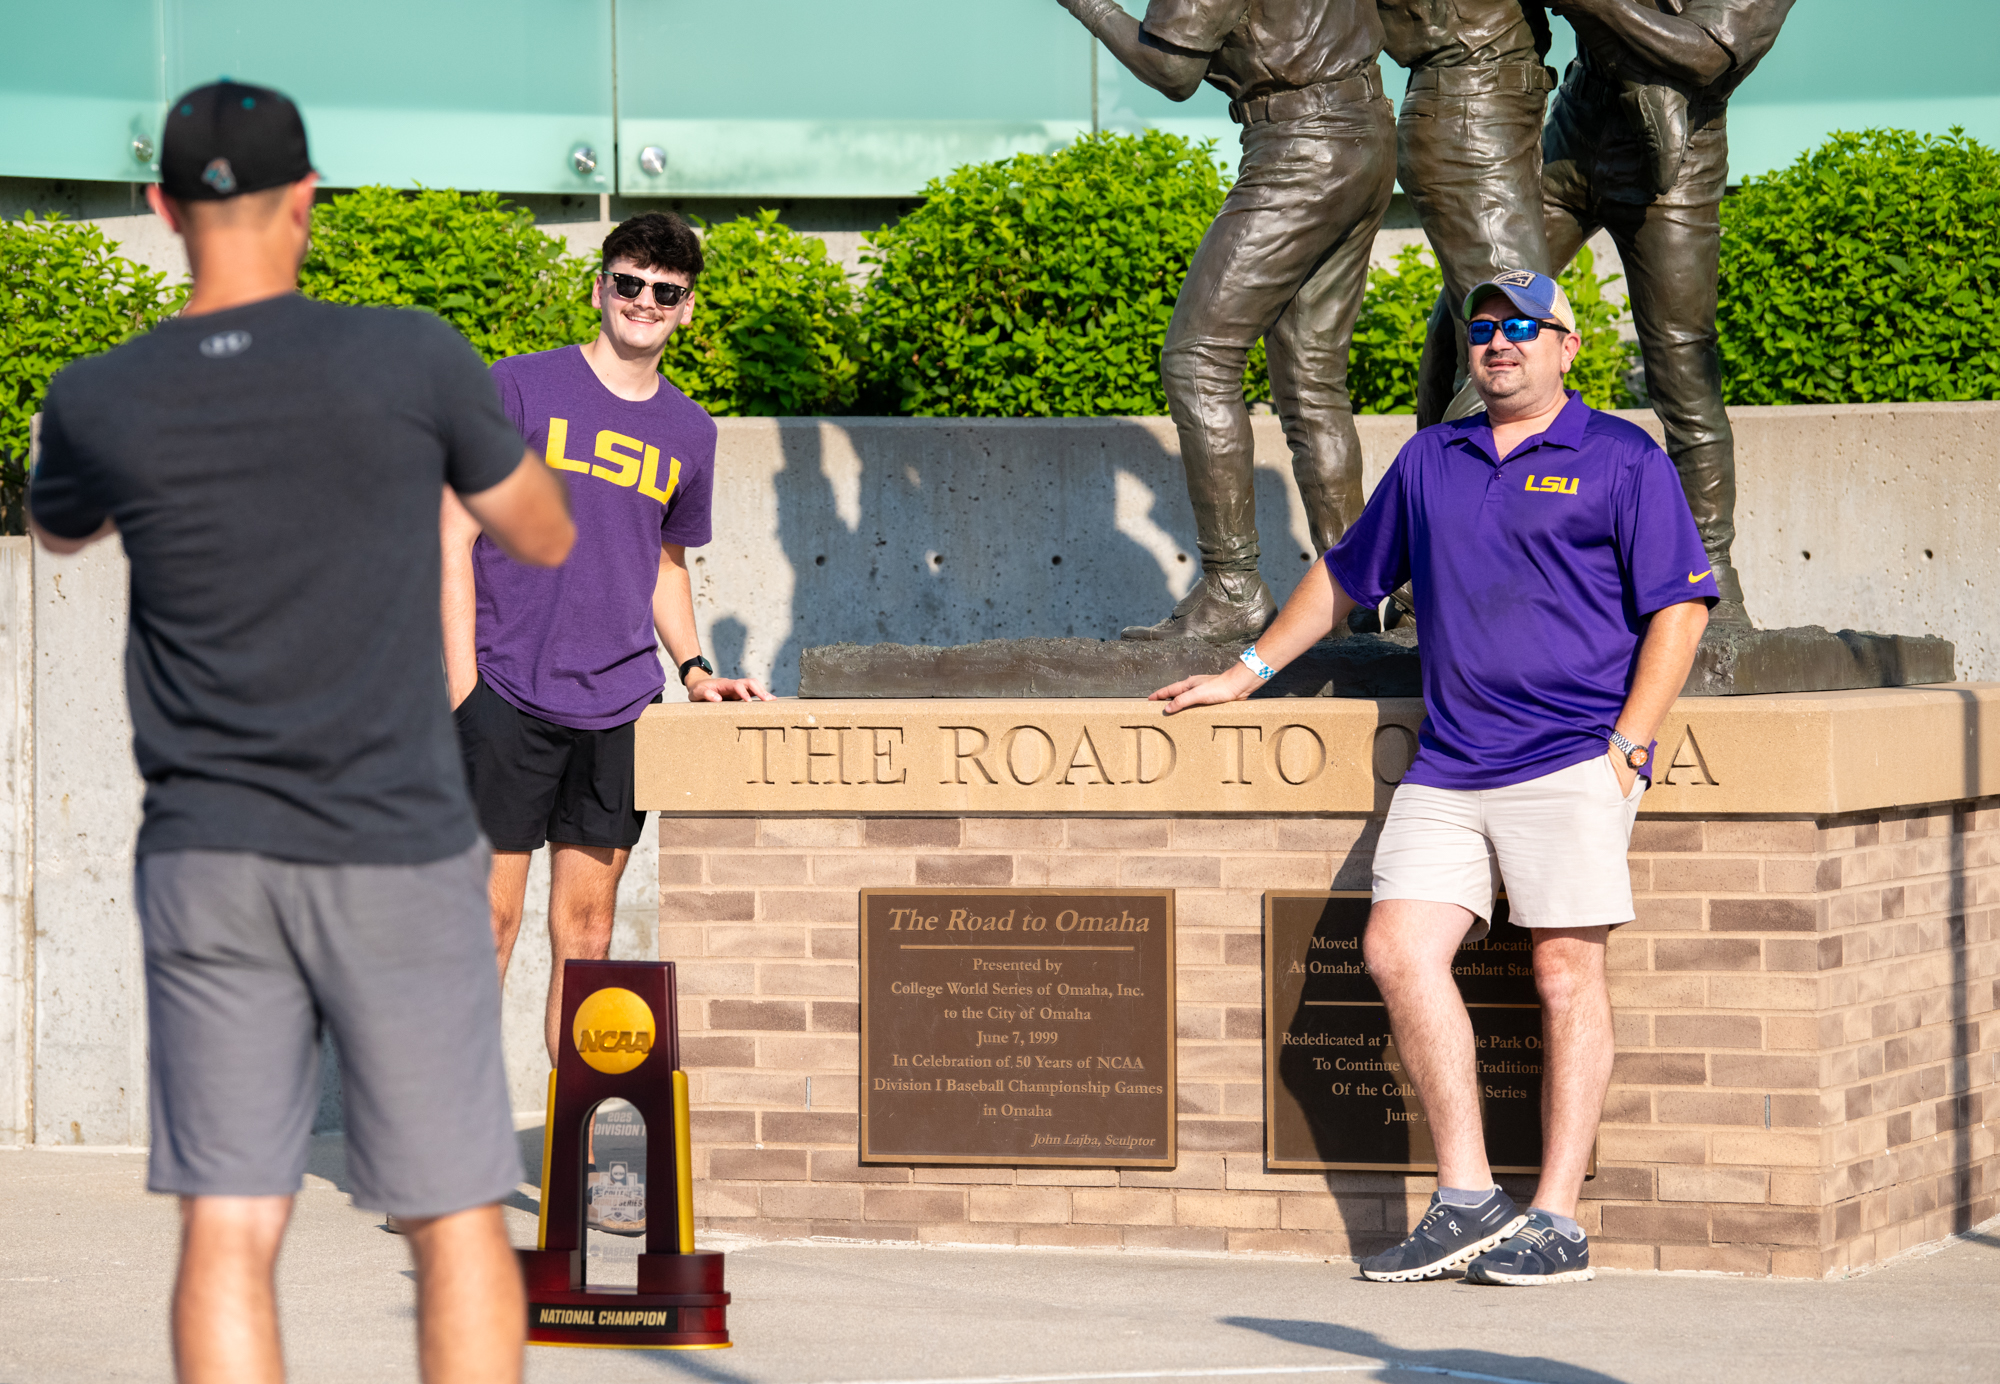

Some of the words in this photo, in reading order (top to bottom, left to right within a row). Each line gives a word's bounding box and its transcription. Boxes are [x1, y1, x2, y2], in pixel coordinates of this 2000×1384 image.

[545, 417, 682, 505] LSU
[1524, 474, 1579, 494] LSU
[736, 725, 907, 785] THE
[938, 724, 1178, 785] ROAD
[1211, 724, 1327, 786] TO
[889, 908, 938, 931] The
[945, 908, 1016, 932] Road
[1022, 912, 1047, 932] to
[1055, 909, 1150, 932] Omaha
[1311, 937, 1358, 950] Moved
[1483, 938, 1534, 951] Locatio
[972, 958, 1041, 972] Presented
[1045, 959, 1063, 975] by
[1290, 961, 1306, 974] At
[1450, 963, 1504, 976] senblatt
[891, 982, 943, 998] College
[946, 982, 989, 996] World
[992, 983, 1033, 996] Series
[1036, 982, 1053, 996] of
[1057, 984, 1113, 999] Omaha,
[1117, 984, 1145, 997] Inc.
[944, 1008, 957, 1020] to
[962, 1007, 984, 1020] the
[987, 1007, 1015, 1023] City
[1019, 1007, 1035, 1020] of
[1040, 1008, 1091, 1021] Omaha
[578, 1029, 652, 1055] NCAA
[976, 1030, 1008, 1047] June
[1012, 1031, 1025, 1046] 7,
[1028, 1031, 1059, 1045] 1999
[1282, 1032, 1364, 1046] Rededicated
[1368, 1036, 1380, 1047] at
[1490, 1035, 1522, 1049] Park
[892, 1055, 908, 1067] In
[912, 1054, 992, 1068] Celebration
[995, 1055, 1012, 1068] of
[1015, 1056, 1031, 1069] 50
[1034, 1055, 1073, 1069] Years
[1076, 1056, 1093, 1069] of
[1095, 1057, 1145, 1070] NCAA
[1313, 1057, 1332, 1070] To
[1335, 1057, 1400, 1071] Continue
[873, 1078, 931, 1091] Division
[935, 1079, 942, 1091] I
[945, 1079, 1004, 1092] Baseball
[1008, 1079, 1110, 1097] Championship
[1114, 1081, 1163, 1095] Games
[1332, 1082, 1352, 1095] Of
[1356, 1083, 1378, 1096] the
[1485, 1085, 1527, 1098] Series
[607, 1112, 633, 1123] 2025
[983, 1103, 997, 1116] in
[1000, 1104, 1052, 1117] Omaha
[1384, 1108, 1419, 1125] June
[594, 1124, 639, 1136] DIVISION
[1030, 1133, 1061, 1148] John
[1063, 1134, 1101, 1148] Lajba,
[1104, 1134, 1156, 1149] Sculptor
[540, 1308, 596, 1325] NATIONAL
[598, 1310, 667, 1326] CHAMPION
